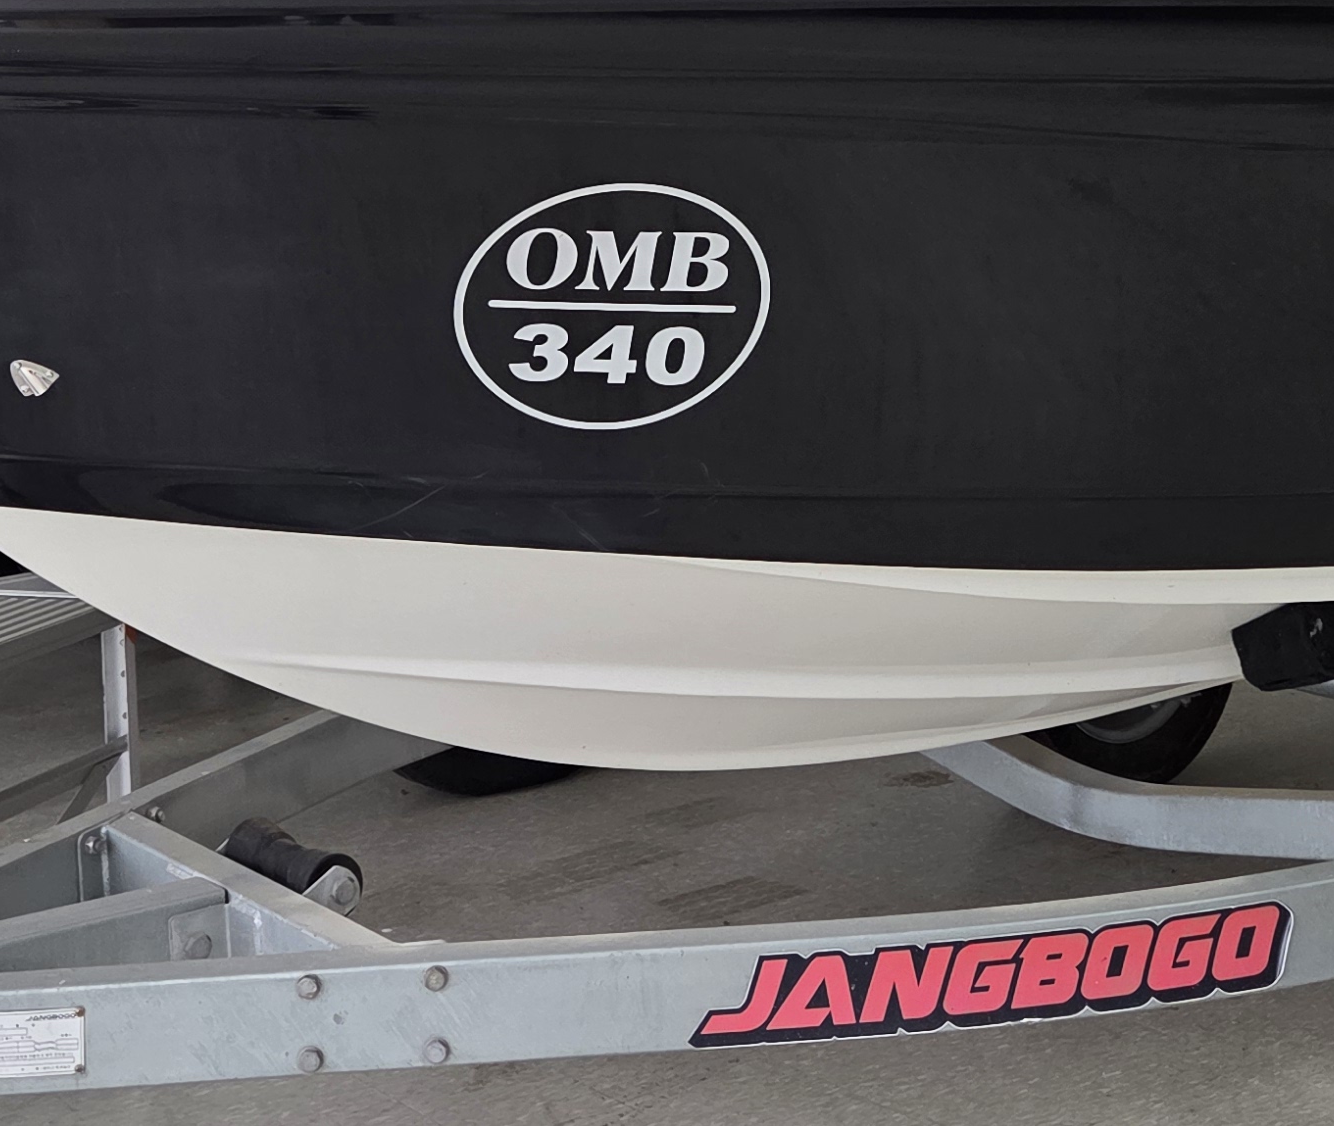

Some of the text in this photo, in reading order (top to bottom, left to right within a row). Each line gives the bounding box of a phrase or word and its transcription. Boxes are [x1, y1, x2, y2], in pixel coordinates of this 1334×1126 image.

[506, 227, 730, 292] OMB
[508, 323, 705, 386] 340
[698, 904, 1281, 1035] JANGBOGO
